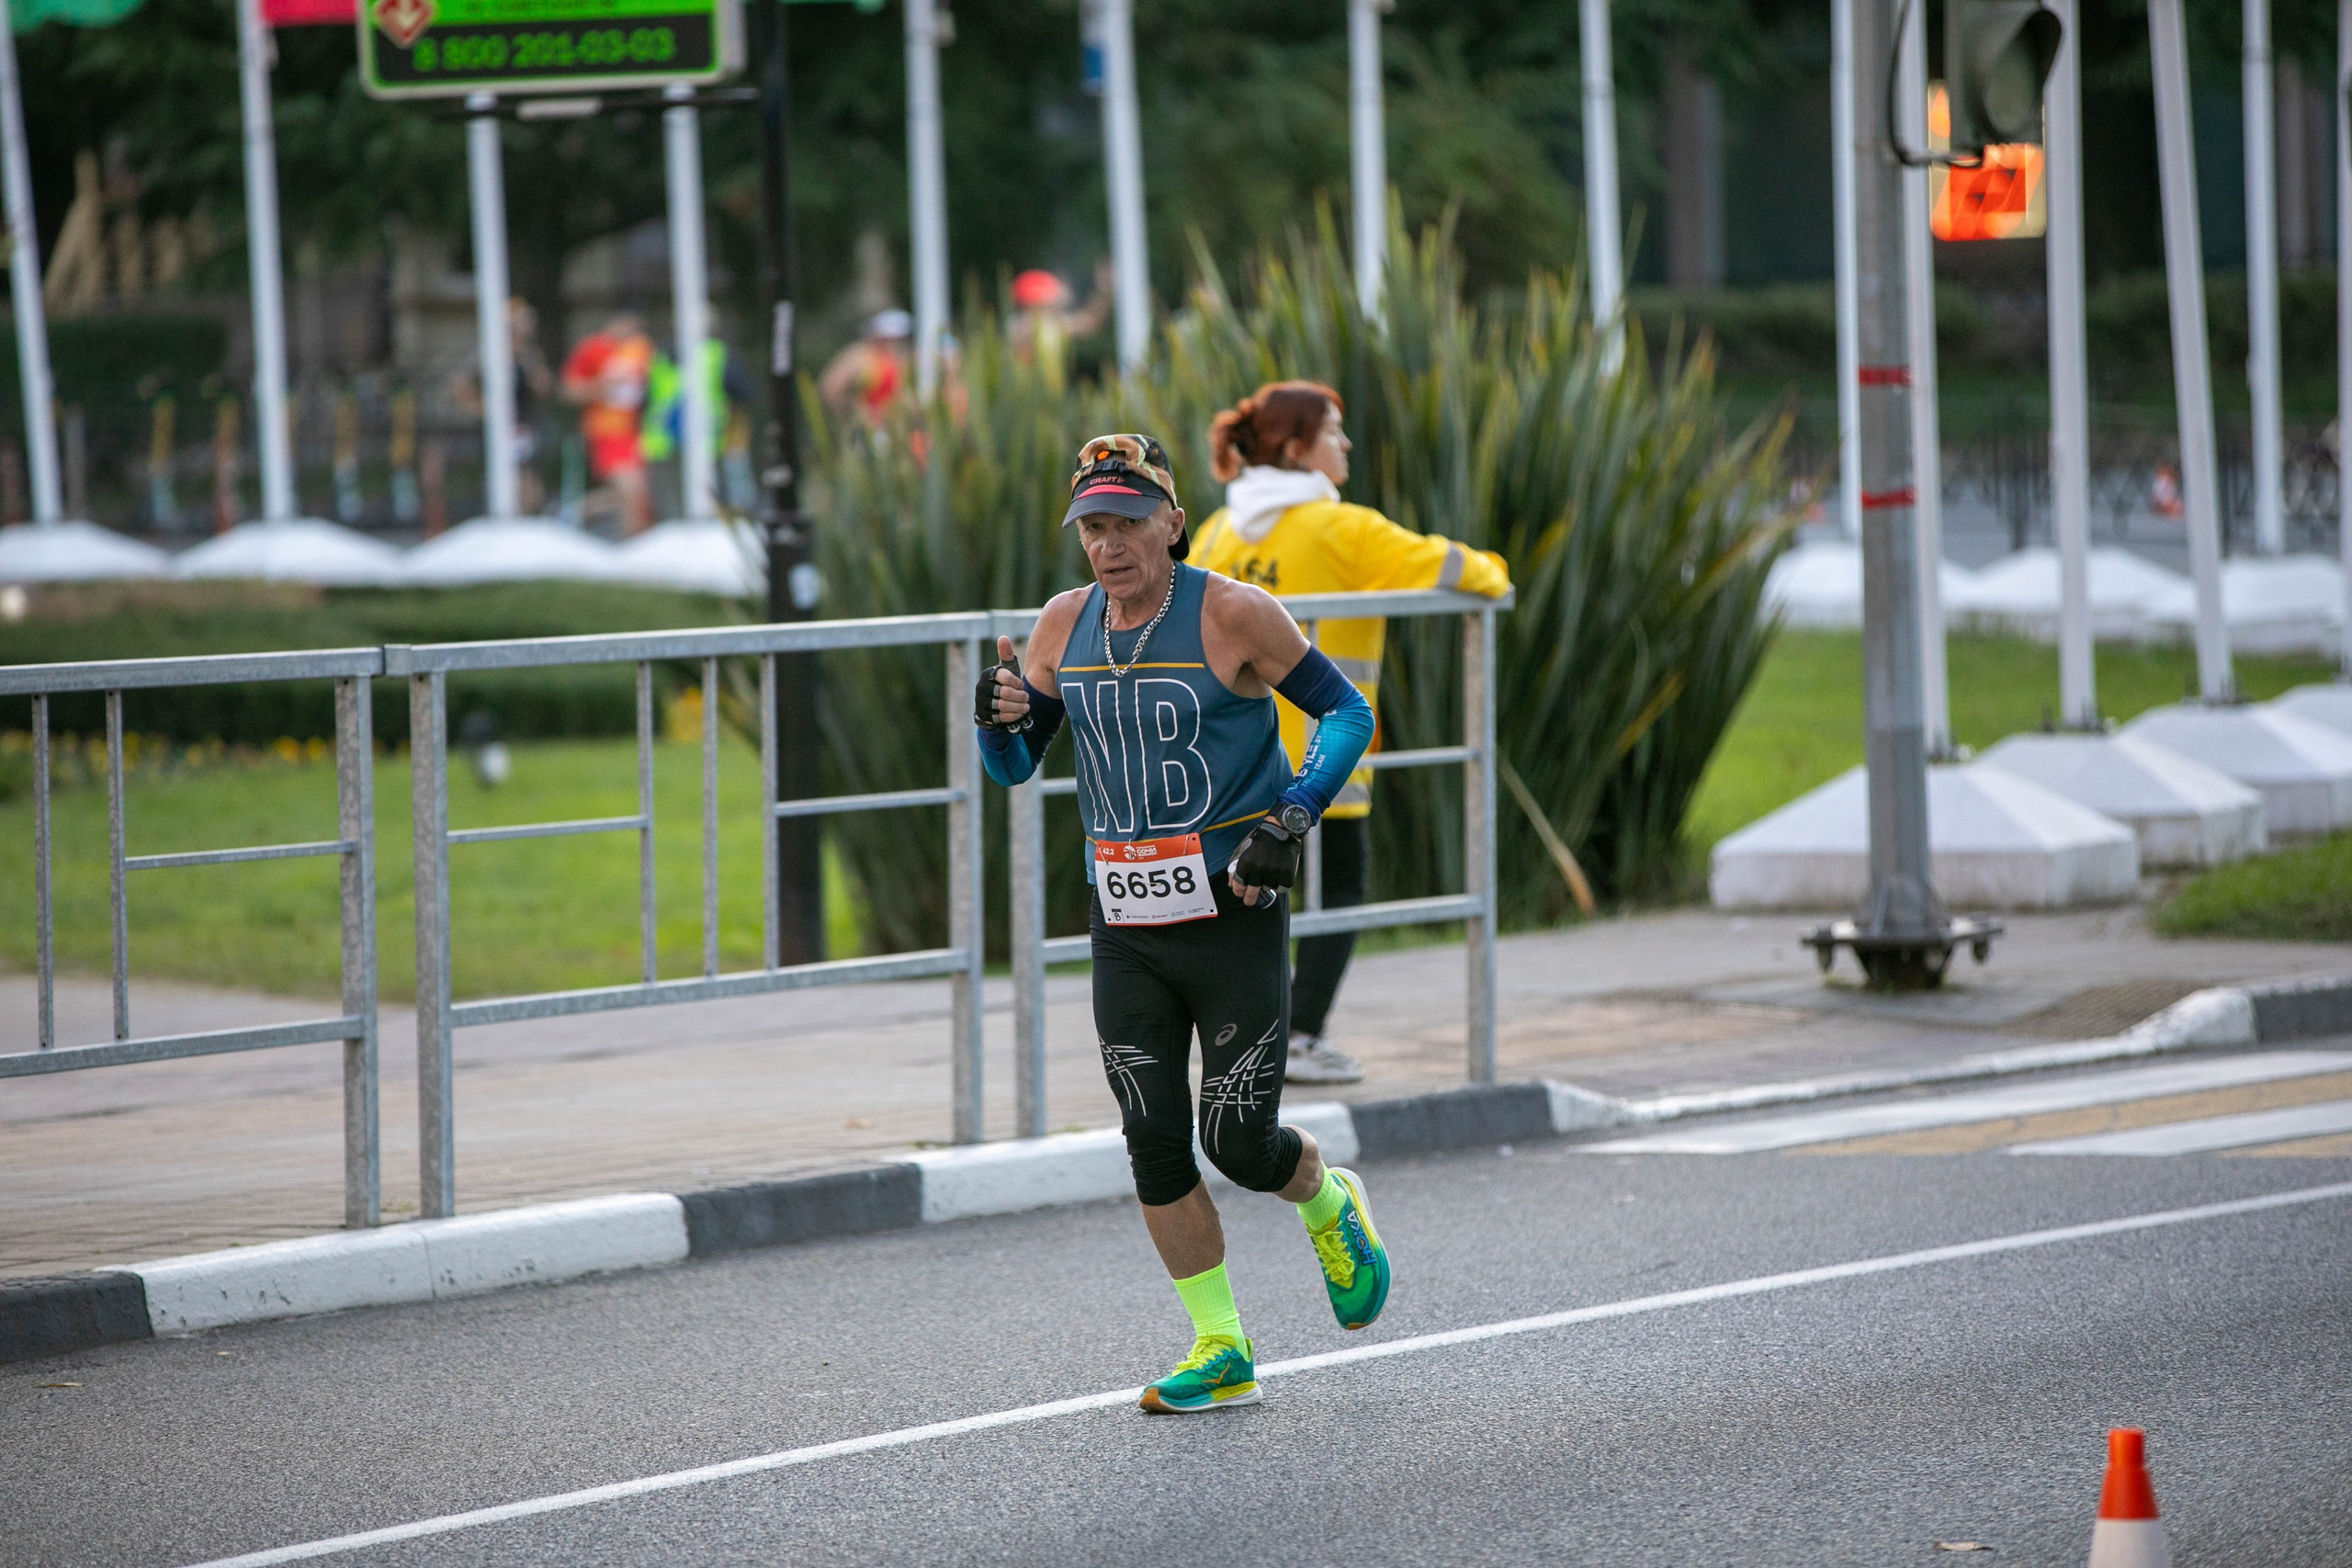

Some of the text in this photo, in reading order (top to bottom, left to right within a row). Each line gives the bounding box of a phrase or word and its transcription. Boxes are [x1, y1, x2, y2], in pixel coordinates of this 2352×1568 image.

[1089, 476, 1118, 486] CRAFT
[1061, 678, 1212, 833] NB
[1315, 754, 1326, 770] TEAM
[1102, 847, 1114, 855] 42.2
[1107, 866, 1196, 899] 6658
[1347, 1210, 1377, 1265] HOKA
